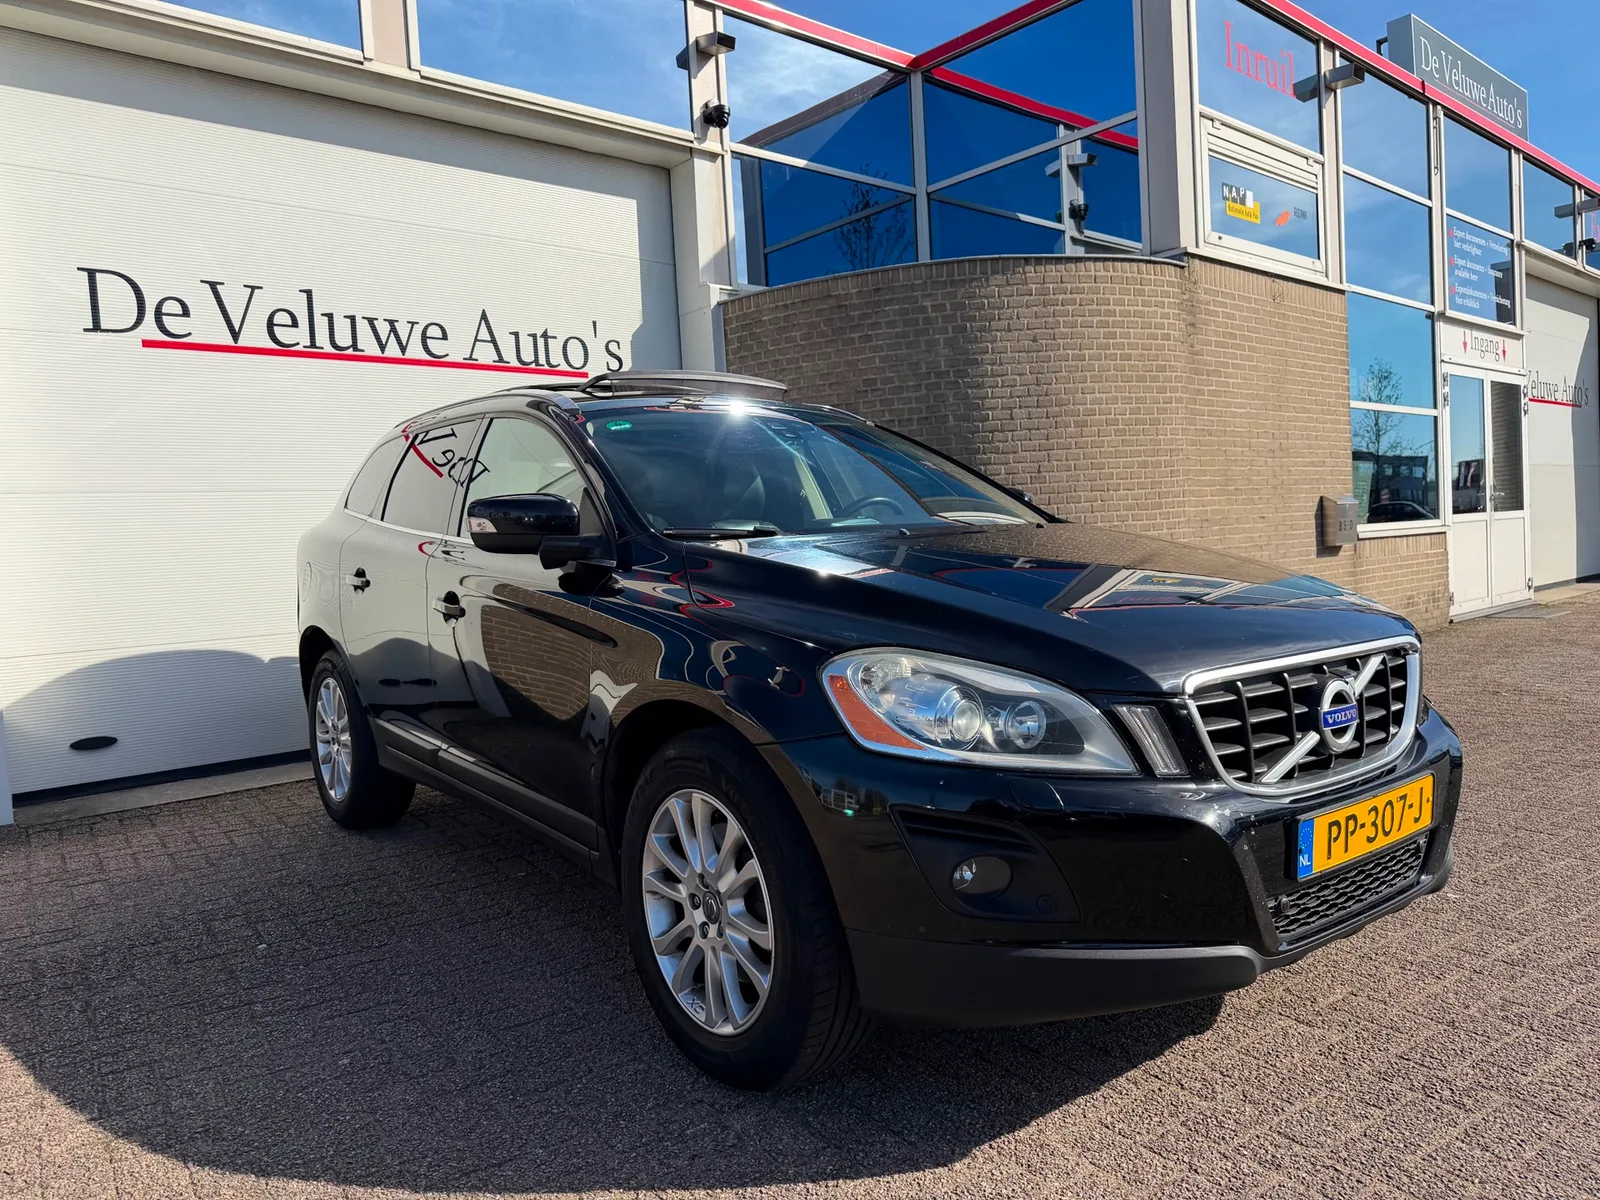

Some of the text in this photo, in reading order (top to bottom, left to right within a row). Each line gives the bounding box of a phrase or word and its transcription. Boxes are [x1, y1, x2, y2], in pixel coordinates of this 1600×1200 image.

[1223, 19, 1296, 99] Inruil
[1420, 36, 1522, 128] De Veluwe Auto's
[1223, 185, 1245, 199] NAP
[77, 266, 624, 373] De Veluwe Auto's
[1470, 329, 1500, 362] Ingang
[1561, 375, 1589, 405] Auto's
[1325, 709, 1357, 724] VOLVO
[1327, 787, 1423, 860] PP-307-J
[1299, 854, 1311, 868] NL
